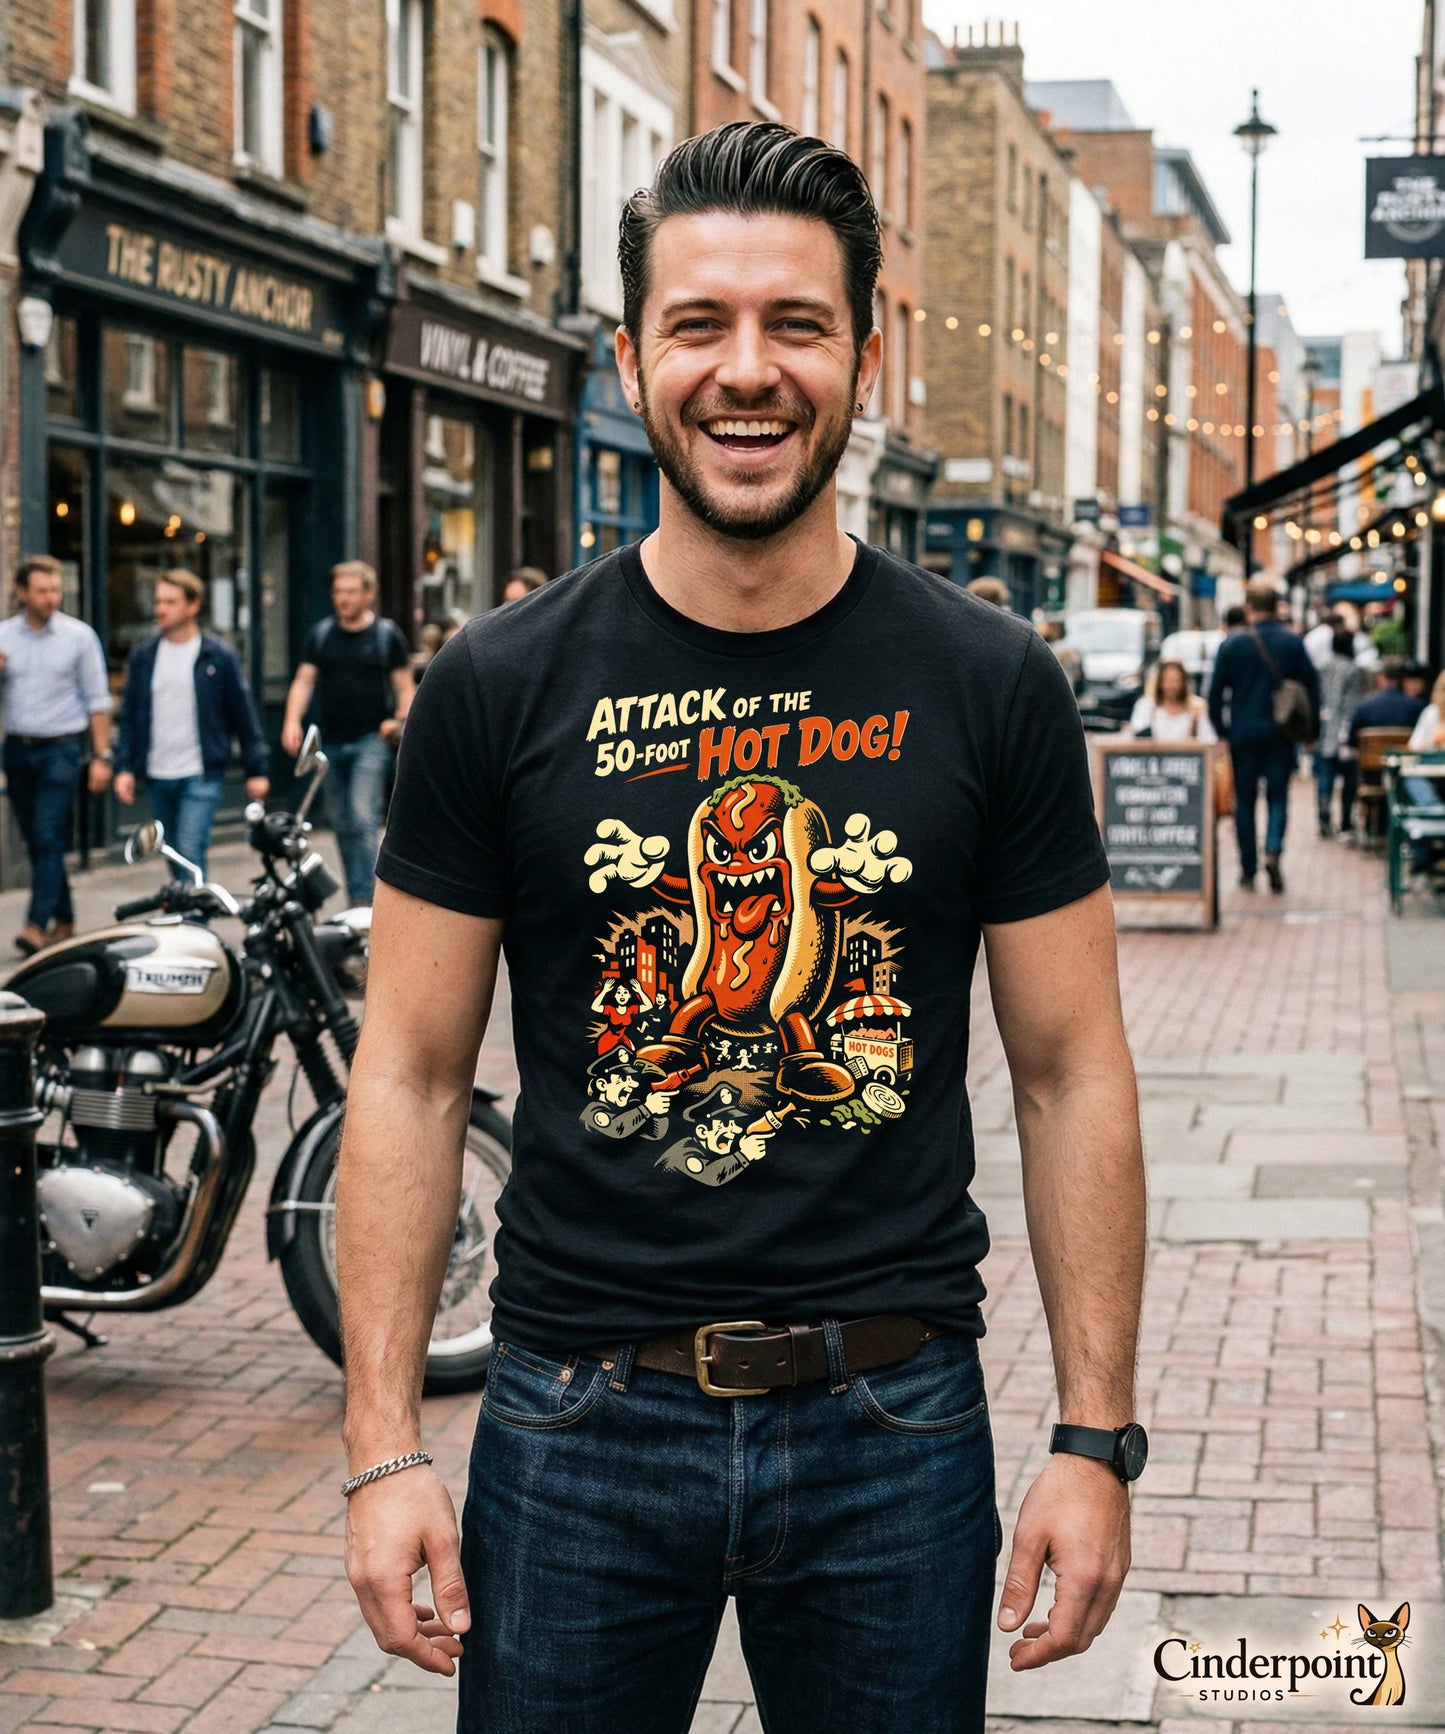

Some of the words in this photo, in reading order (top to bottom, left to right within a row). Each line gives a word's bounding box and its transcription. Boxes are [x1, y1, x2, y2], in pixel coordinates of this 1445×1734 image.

[106, 223, 154, 286] THE
[156, 240, 231, 307] RUSTY
[229, 266, 314, 332] ANCHOR
[586, 687, 727, 742] ATTACK
[733, 697, 761, 719] OF
[769, 690, 812, 713] THE
[594, 738, 691, 777] 50-FOOT
[697, 723, 790, 781] HOT
[798, 710, 909, 767] DOG!
[137, 971, 202, 986] TRIUMPH
[849, 1041, 867, 1053] HOT
[869, 1045, 895, 1058] DOGS
